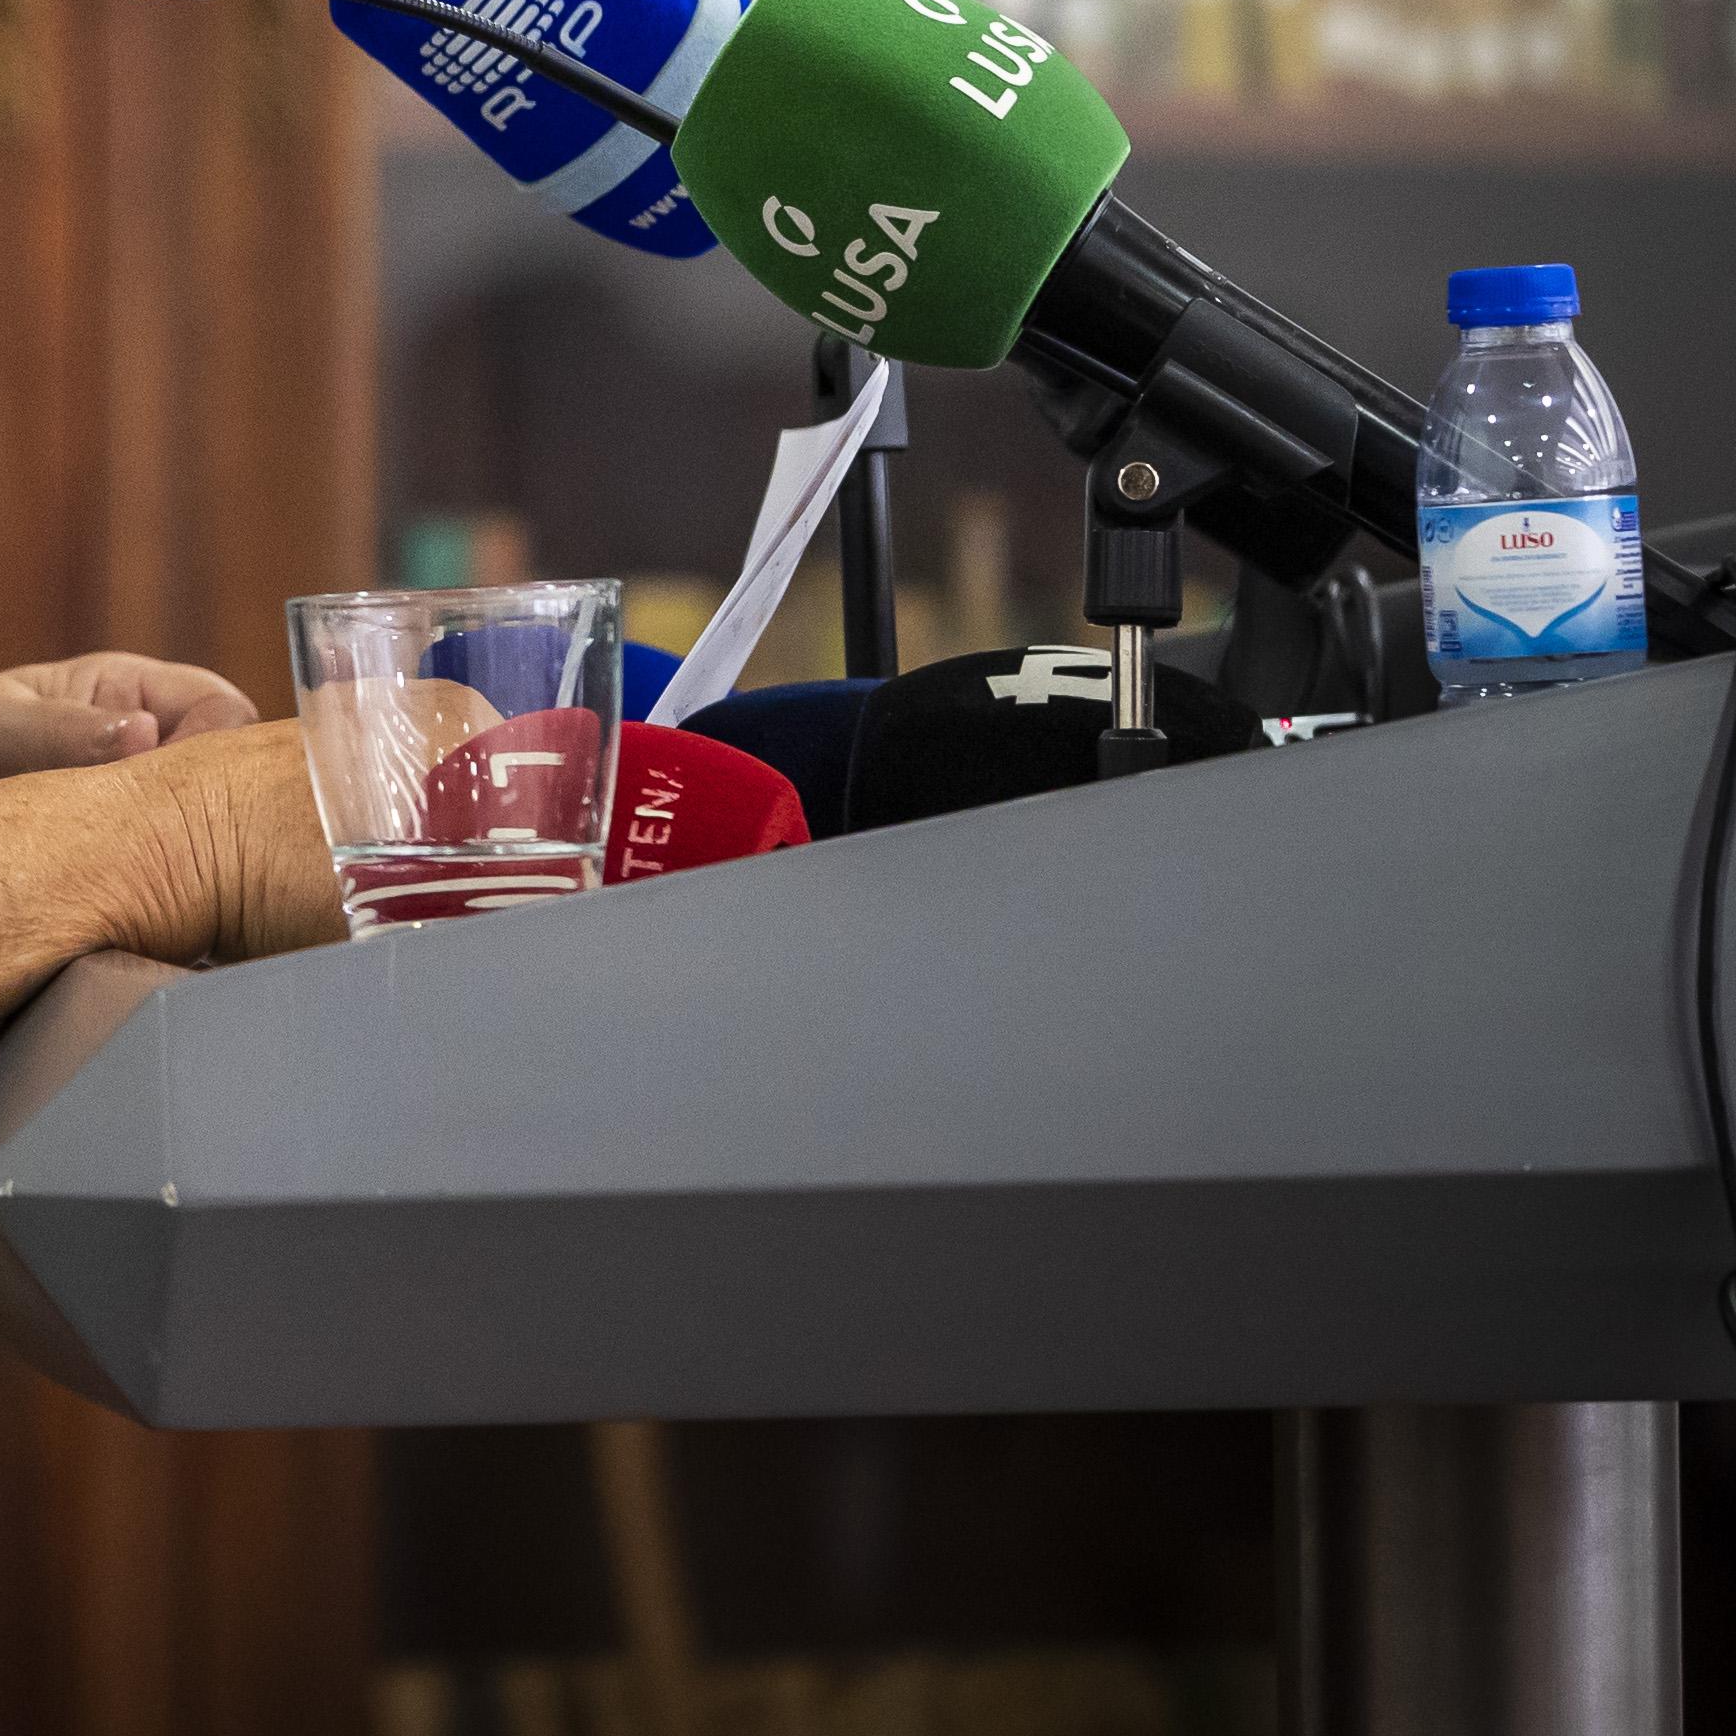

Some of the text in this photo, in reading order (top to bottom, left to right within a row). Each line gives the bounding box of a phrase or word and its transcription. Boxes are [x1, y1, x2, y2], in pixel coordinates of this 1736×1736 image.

[480, 0, 603, 131] RP
[811, 203, 941, 345] LUSA
[1500, 532, 1554, 550] LUSO
